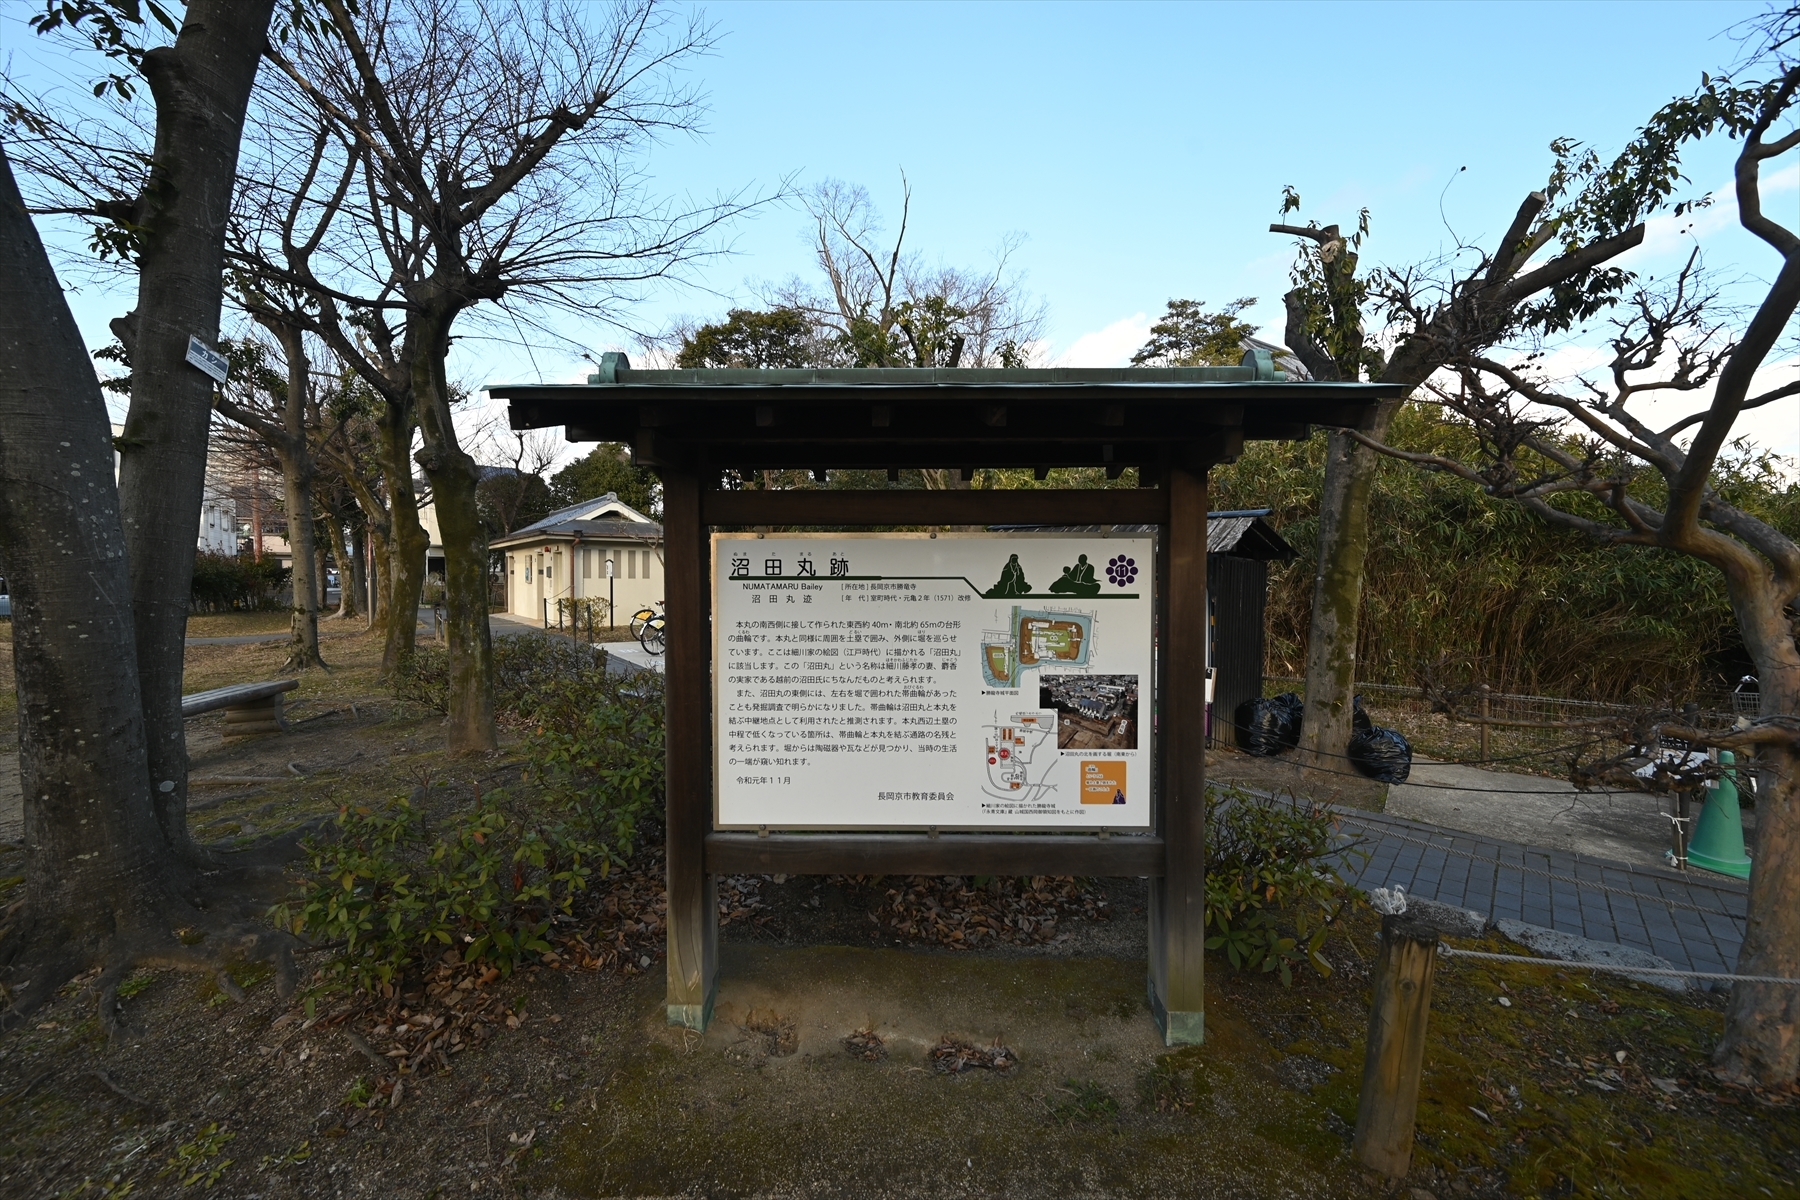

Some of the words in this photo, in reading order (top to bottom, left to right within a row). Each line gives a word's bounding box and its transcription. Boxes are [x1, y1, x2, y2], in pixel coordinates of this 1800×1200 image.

[731, 557, 849, 577] 沼田丸跡
[1116, 566, 1127, 576] 11
[801, 583, 823, 592] Bailey
[751, 594, 813, 604] 沼田丸迹
[878, 792, 954, 801] 長岡京市教育委員会
